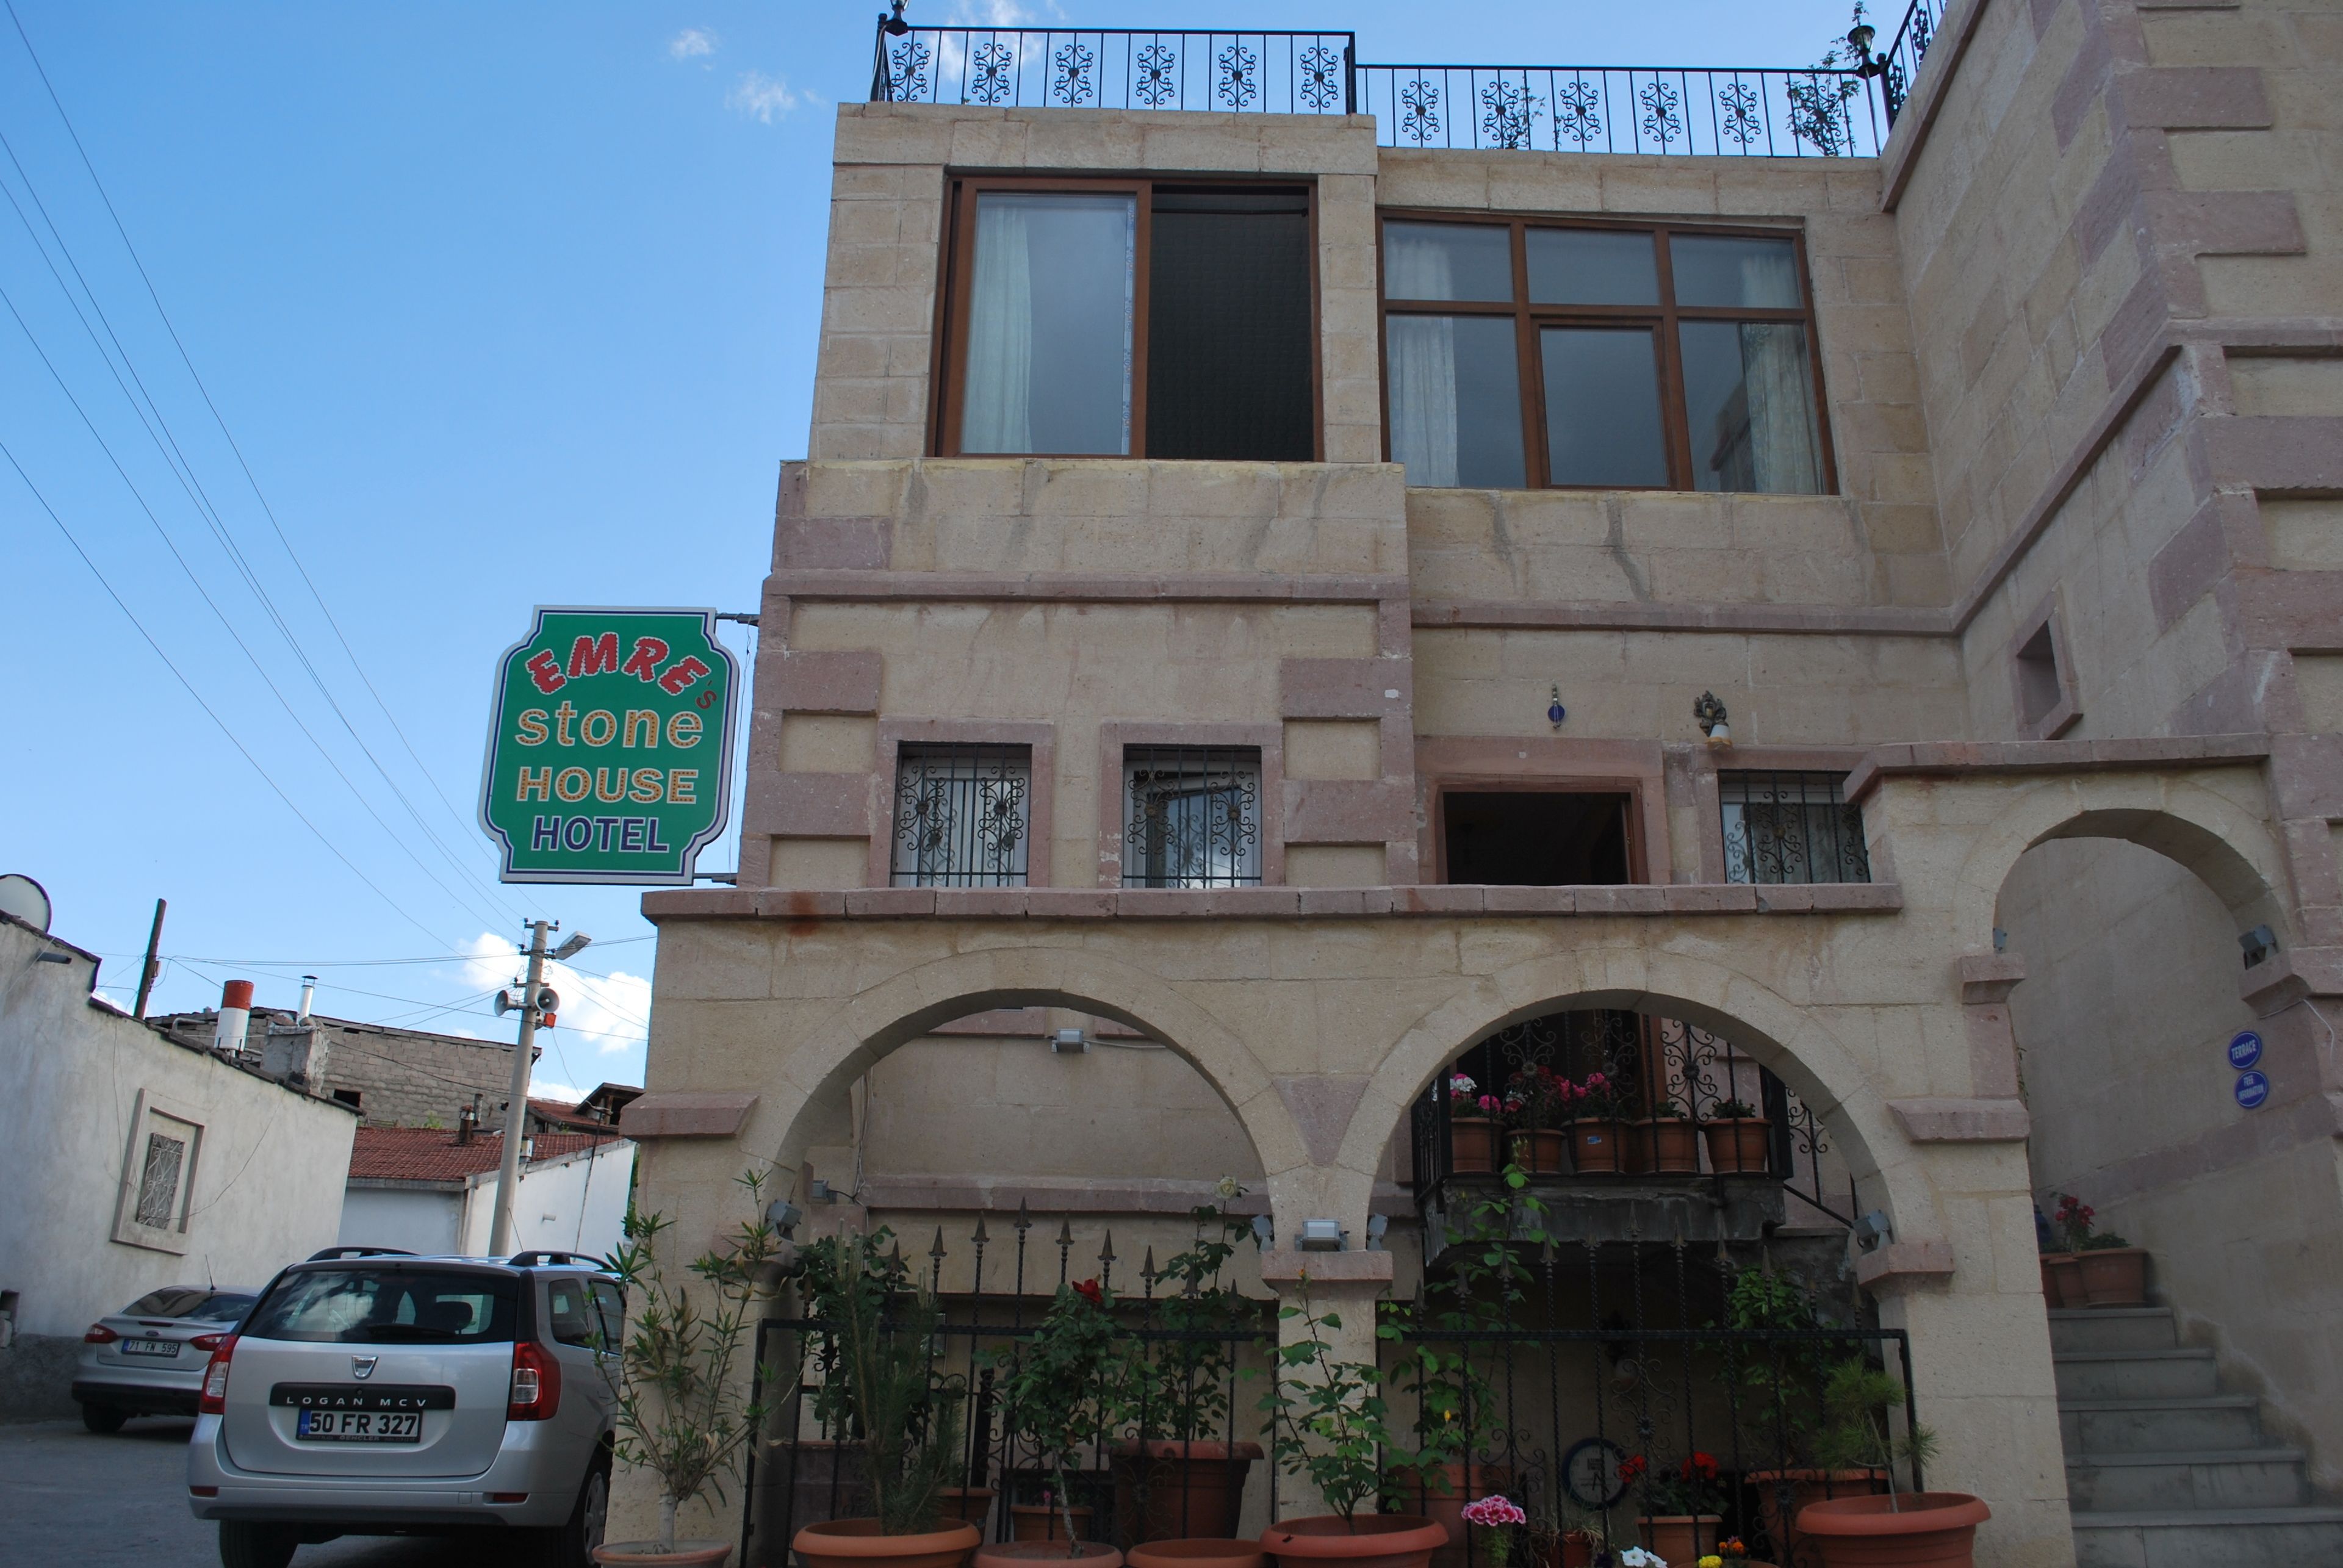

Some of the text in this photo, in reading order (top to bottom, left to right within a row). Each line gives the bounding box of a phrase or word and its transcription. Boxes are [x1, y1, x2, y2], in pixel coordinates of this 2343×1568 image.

[514, 700, 704, 749] stone
[516, 766, 699, 804] HOUSE
[531, 815, 670, 854] HOTEL
[2231, 1040, 2256, 1060] TERRACE
[2244, 1075, 2253, 1086] FREE
[129, 1341, 139, 1351] 71
[162, 1343, 177, 1353] 595
[286, 1397, 426, 1407] LOGAN MCV
[310, 1412, 417, 1435] 50 FR 327
